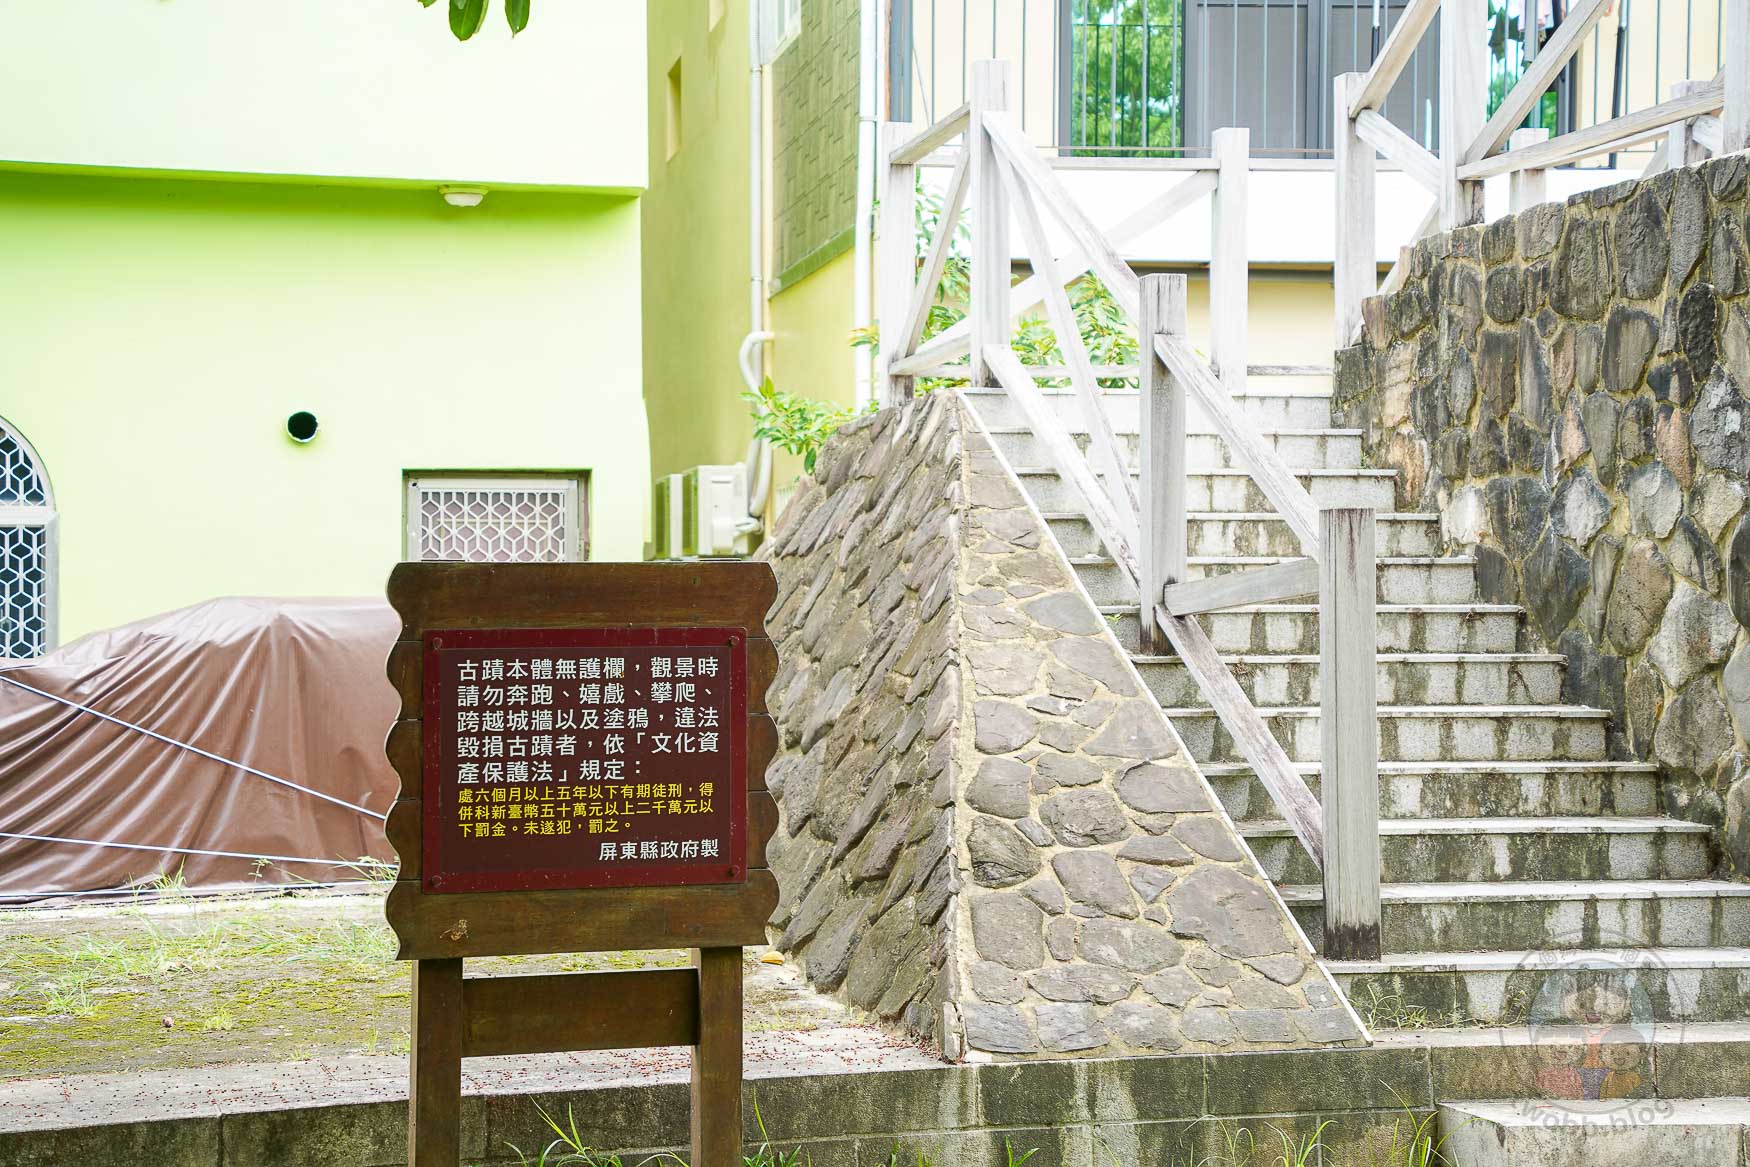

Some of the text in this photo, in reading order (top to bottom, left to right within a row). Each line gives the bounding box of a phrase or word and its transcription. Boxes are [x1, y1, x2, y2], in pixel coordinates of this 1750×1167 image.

[457, 657, 719, 681] 古蹟本體無護欄，觀景時
[457, 682, 711, 706] 請勿奔跑、嬉戲、攀爬、
[457, 706, 719, 732] 跨越城牆以及塗鴉，違法
[458, 731, 719, 757] 毀損古蹟者，依「文化資
[458, 759, 640, 784] 產保護法」規定：
[458, 783, 714, 803] 處六個月以上五年以下有期徒刑，得
[458, 799, 713, 820] 併科新臺幣五十萬元以上二千萬元以
[458, 818, 630, 837] 下罰金。未遂犯，罰之。
[599, 839, 719, 860] 屏東縣政府製
